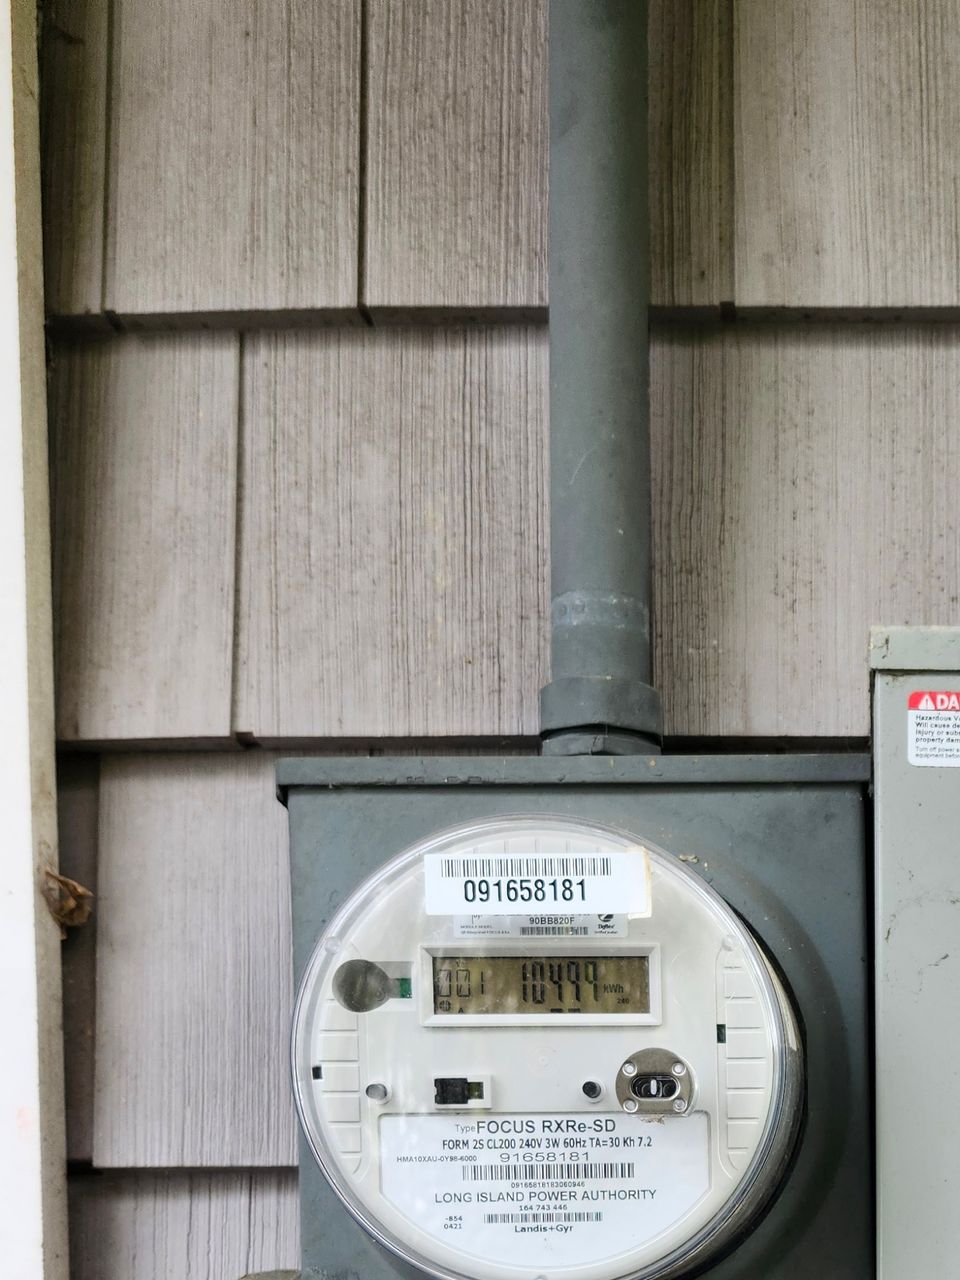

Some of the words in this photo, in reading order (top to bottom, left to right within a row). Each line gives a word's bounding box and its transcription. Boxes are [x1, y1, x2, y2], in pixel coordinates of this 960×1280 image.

[463, 878, 587, 902] 091658181
[529, 916, 575, 925] 90BB820F
[603, 983, 624, 994] kWh
[455, 1123, 476, 1134] Type
[476, 1120, 535, 1134] FOCUS
[542, 1118, 616, 1133] RXRe-SD
[442, 1139, 469, 1150] FORM
[473, 1139, 484, 1150] 2S
[487, 1138, 516, 1149] CL200
[519, 1138, 543, 1149] 240V
[545, 1137, 561, 1149] 3W
[563, 1137, 587, 1149] 60Hz
[588, 1136, 621, 1148] TA=30
[623, 1136, 635, 1148] Kh
[638, 1136, 652, 1147] 7.2
[500, 1151, 590, 1163] 91658181
[435, 1192, 472, 1204] LONG
[476, 1191, 524, 1203] ISLAND
[528, 1190, 578, 1202] POWER
[581, 1189, 657, 1202] AUTHORITY
[514, 1224, 573, 1235] Landis+Gyr
